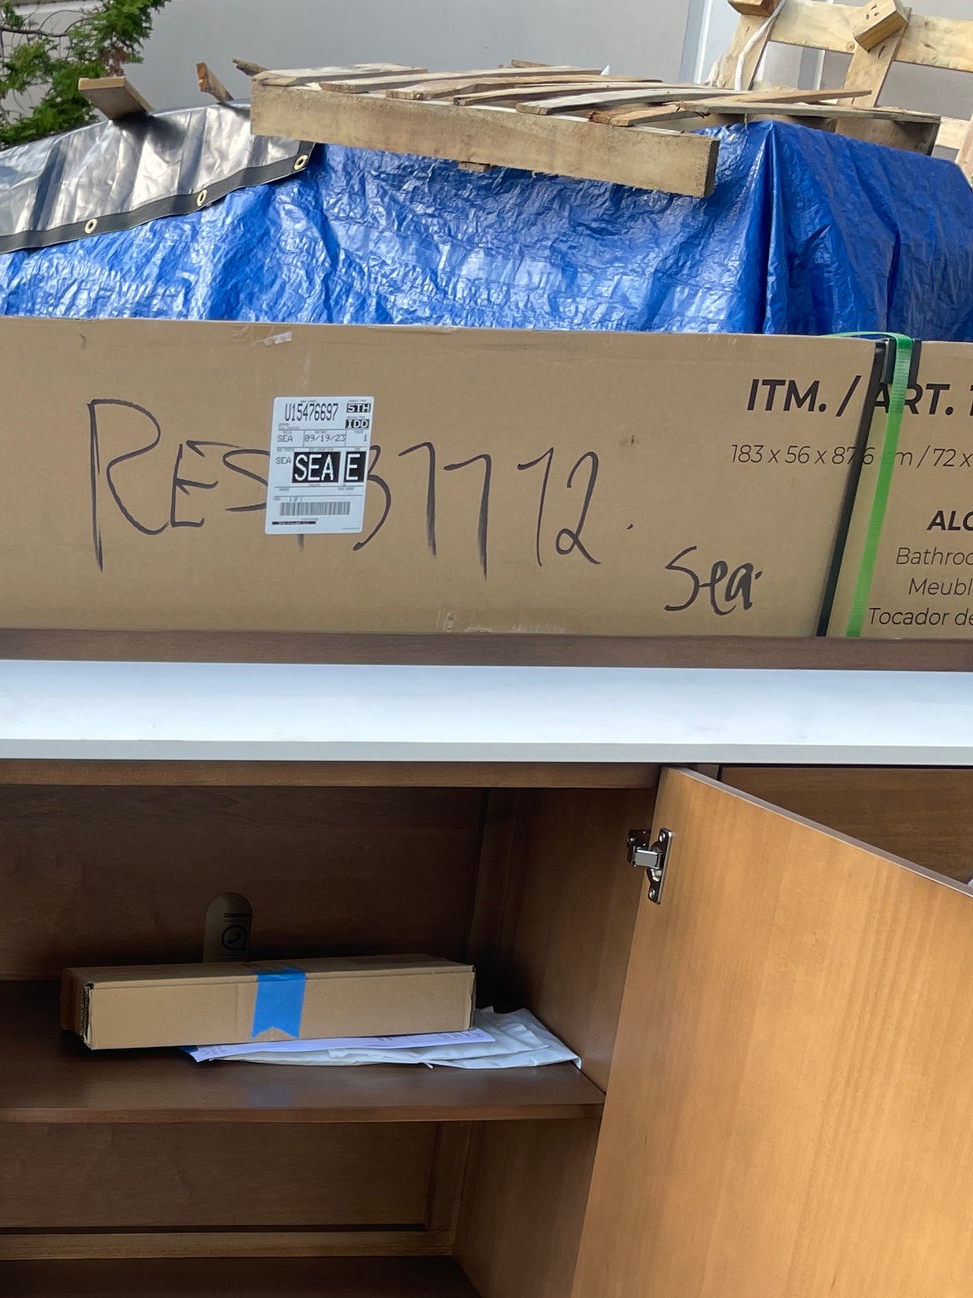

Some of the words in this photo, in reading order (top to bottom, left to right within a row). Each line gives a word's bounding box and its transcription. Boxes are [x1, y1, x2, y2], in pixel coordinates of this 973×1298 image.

[747, 379, 827, 412] ITM.
[835, 375, 862, 417] /
[872, 382, 954, 416] ART.
[284, 403, 339, 421] U15476697
[347, 403, 371, 413] STH
[277, 434, 293, 443] SEA
[304, 434, 346, 443] 09/19/23
[276, 457, 291, 465] SEA
[731, 445, 764, 463] 183
[768, 449, 781, 464] x
[785, 446, 811, 464] 56
[814, 450, 827, 464] x
[831, 446, 875, 465] 876
[933, 448, 957, 467] 72
[294, 453, 334, 481] SEA
[345, 453, 361, 481] E
[868, 607, 950, 626] Tocador
